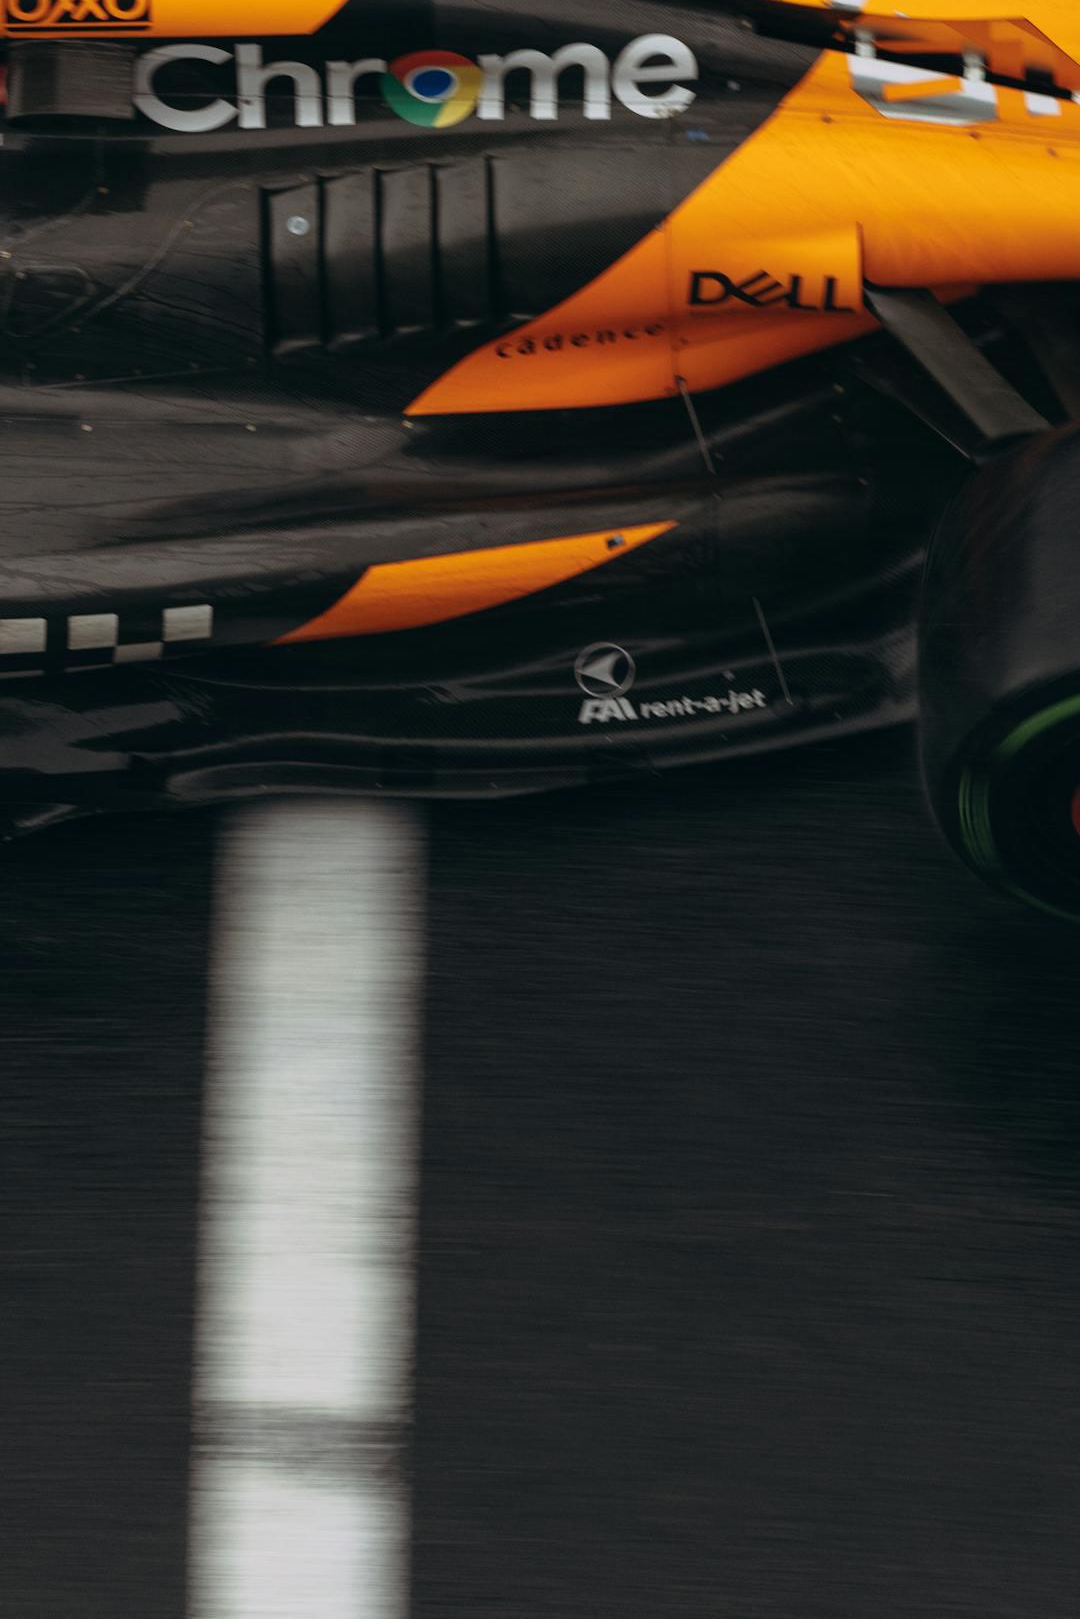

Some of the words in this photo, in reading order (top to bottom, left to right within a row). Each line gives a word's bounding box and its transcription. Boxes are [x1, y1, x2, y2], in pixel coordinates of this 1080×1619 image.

[133, 33, 698, 132] Chrome
[689, 269, 855, 313] DELL
[641, 688, 766, 719] rent-a-jet
